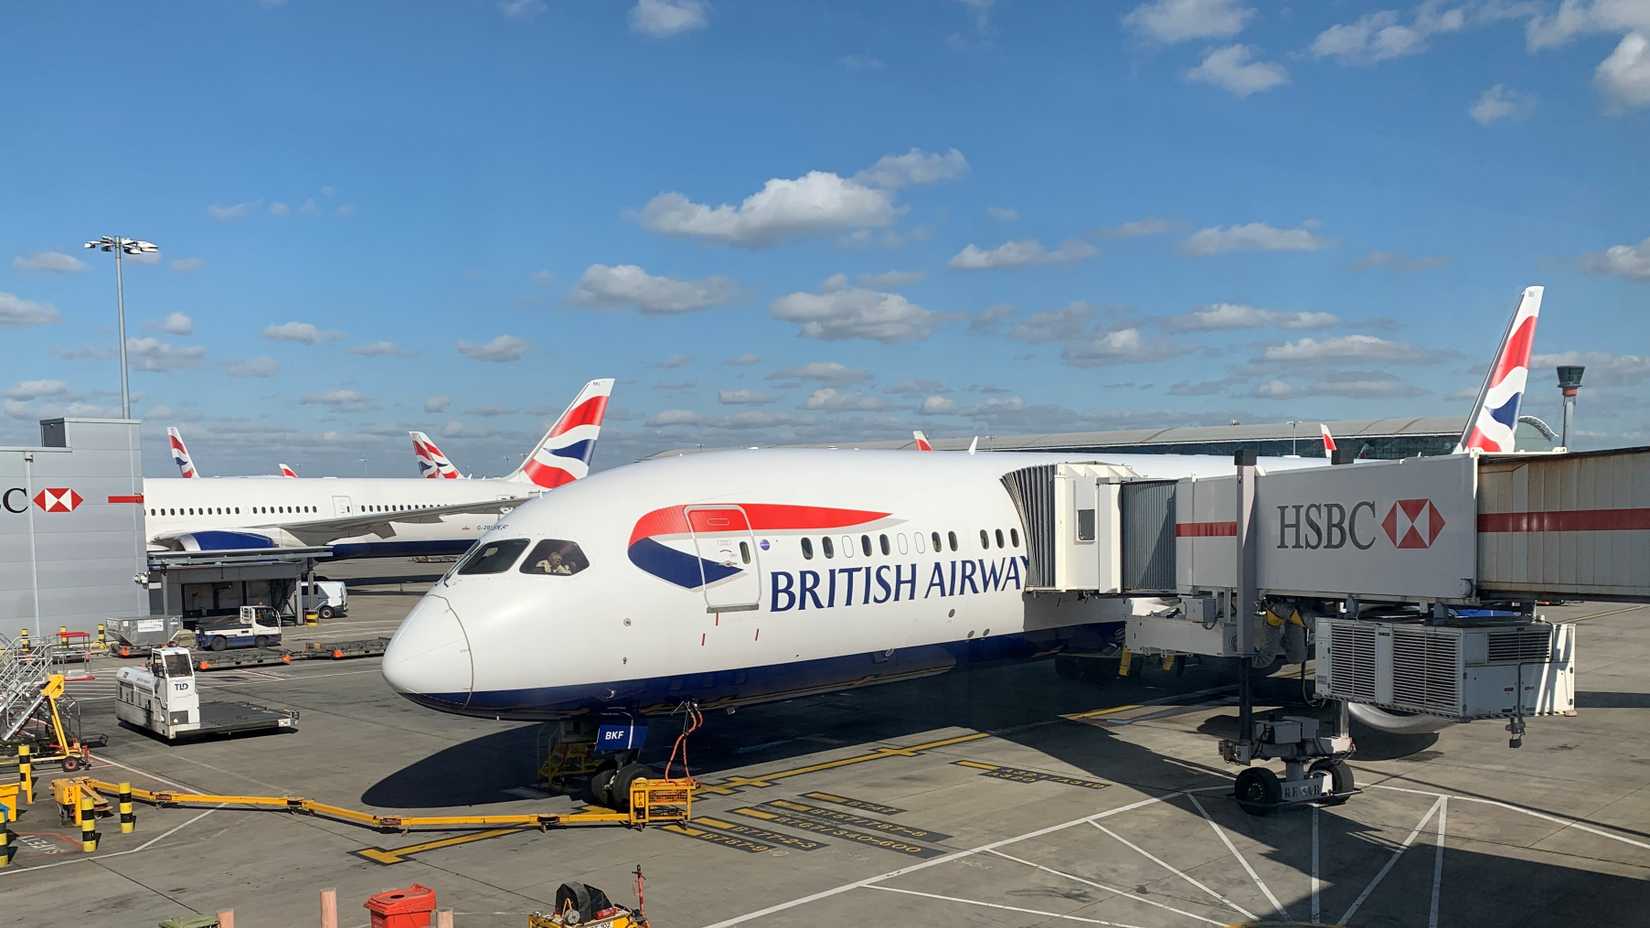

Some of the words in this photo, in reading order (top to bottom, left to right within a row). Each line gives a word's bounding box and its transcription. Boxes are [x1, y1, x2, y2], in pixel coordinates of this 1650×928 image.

[1277, 500, 1377, 551] HSBC
[769, 563, 918, 613] BRITISH
[174, 682, 189, 691] TLD
[605, 730, 625, 741] BKF
